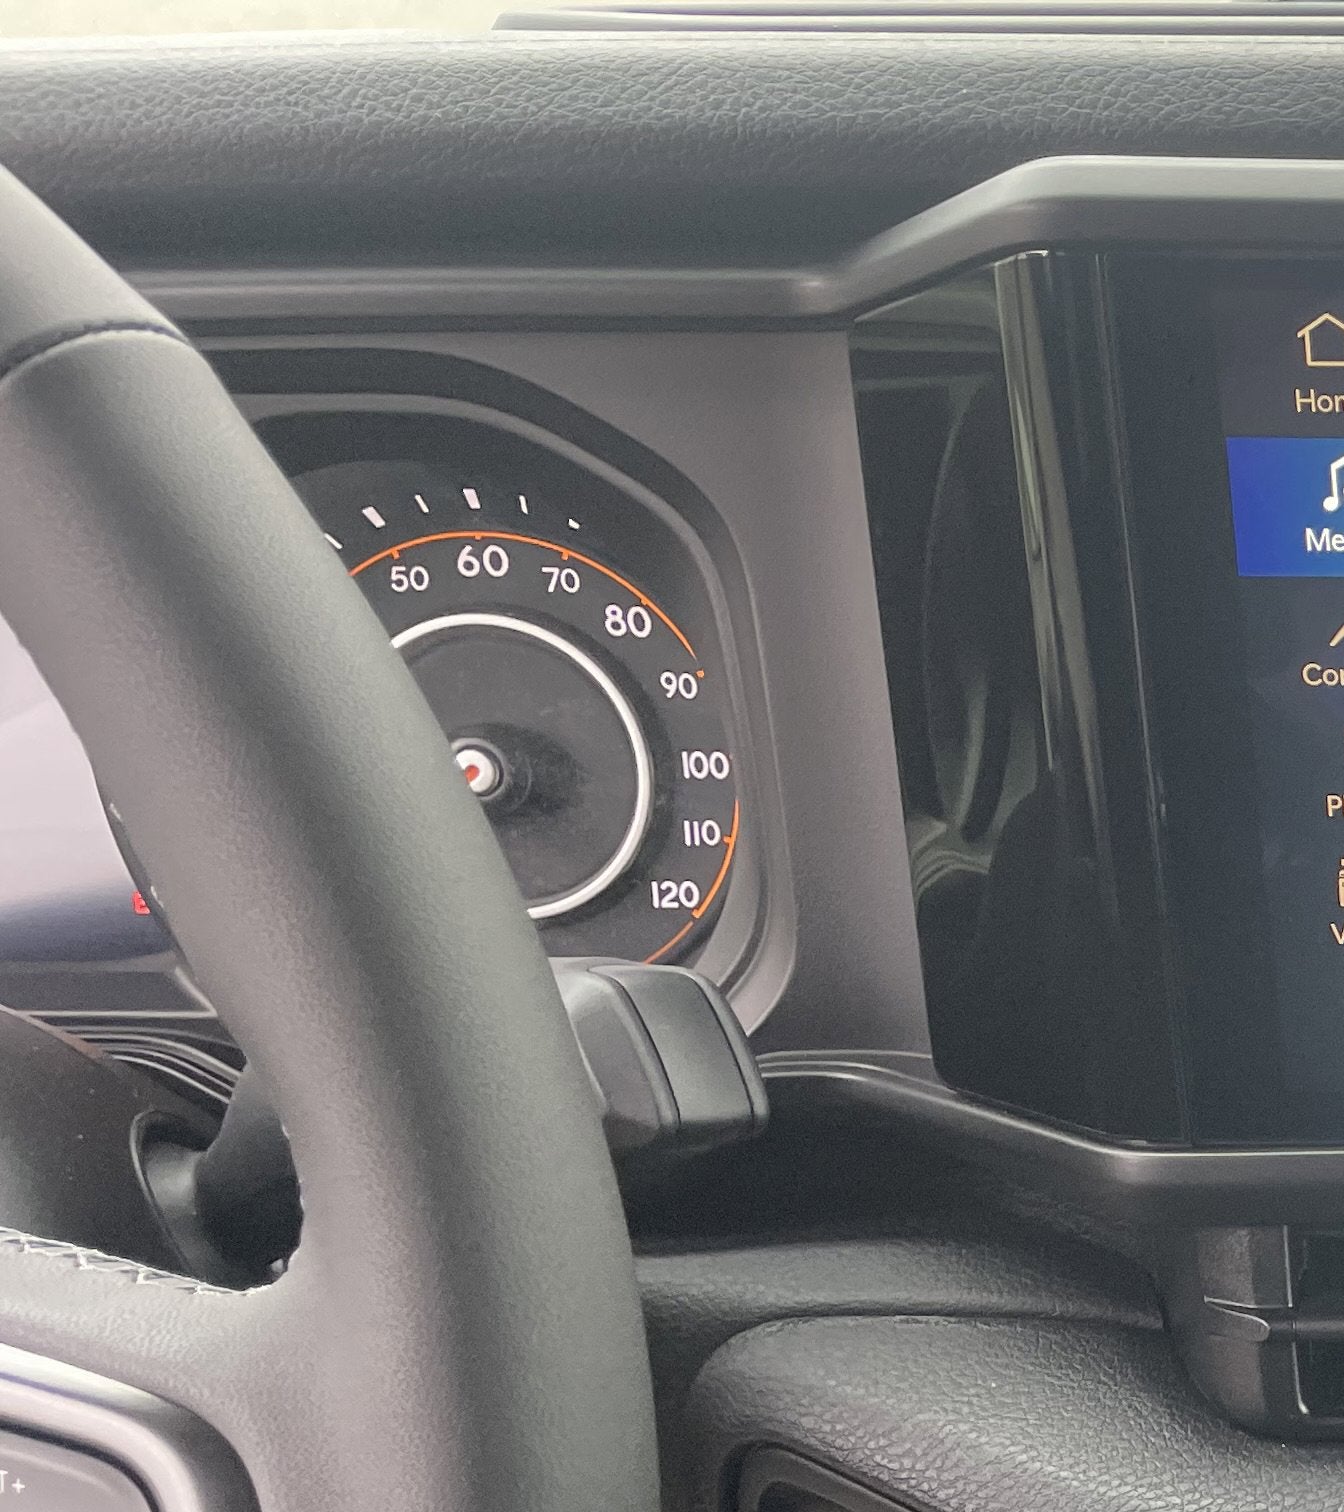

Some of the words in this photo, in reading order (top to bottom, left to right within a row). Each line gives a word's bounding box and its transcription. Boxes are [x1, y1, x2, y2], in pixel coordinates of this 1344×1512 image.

[457, 545, 509, 579] 60
[390, 566, 430, 592] 50
[541, 567, 581, 593] 70
[604, 605, 652, 639] 80
[660, 672, 698, 700] 90
[681, 751, 730, 780] 100
[683, 820, 721, 846] 110
[651, 881, 699, 909] 120
